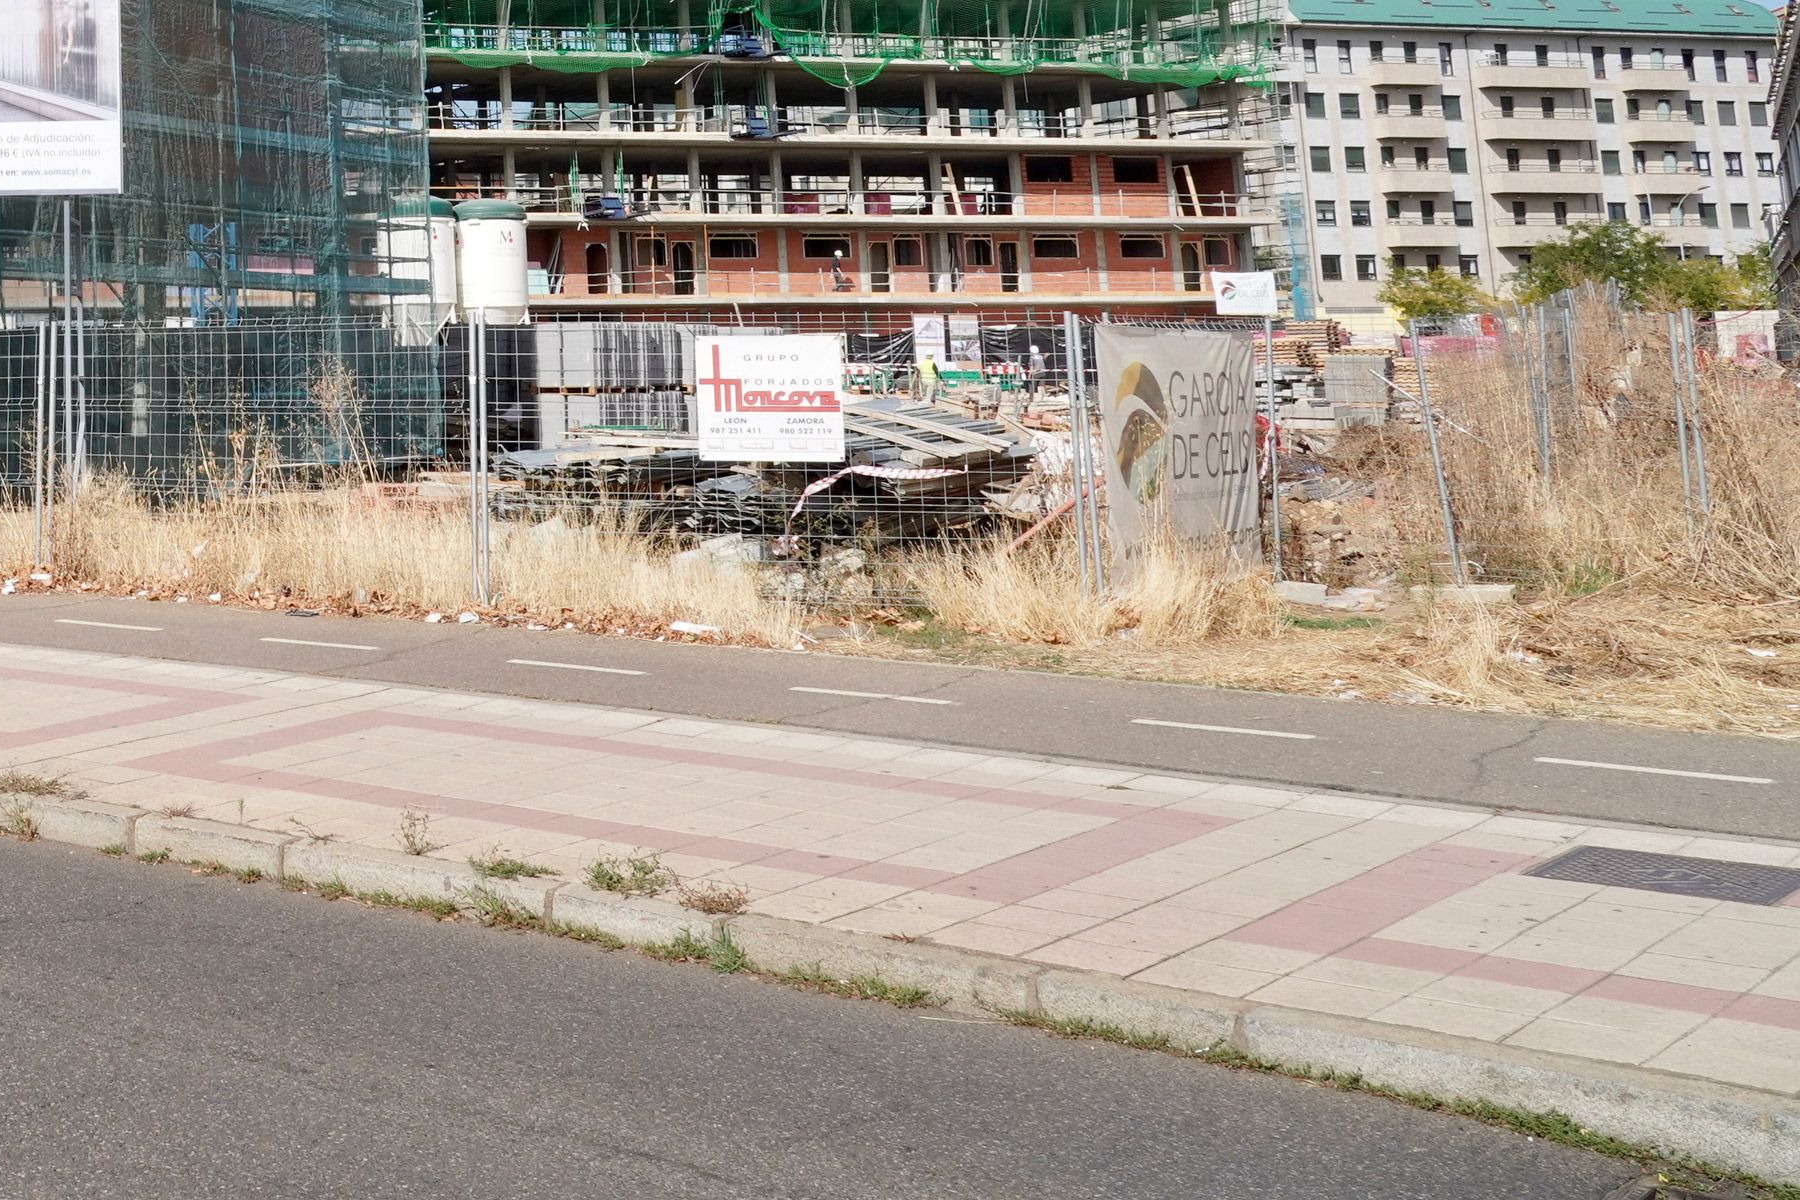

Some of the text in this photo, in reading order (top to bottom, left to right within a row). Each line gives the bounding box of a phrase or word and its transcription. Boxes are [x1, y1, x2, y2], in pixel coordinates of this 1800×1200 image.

[6, 134, 20, 143] de
[22, 132, 94, 145] Adjudicación:
[12, 149, 18, 158] €
[22, 148, 40, 158] (IVA
[58, 148, 101, 158] incluido)
[21, 168, 92, 176] www.somacyl.es
[743, 354, 799, 362] GRUPO
[744, 378, 834, 386] FORJADOS
[1169, 360, 1248, 418] GARCÍA
[1172, 430, 1249, 479] DE CELIS
